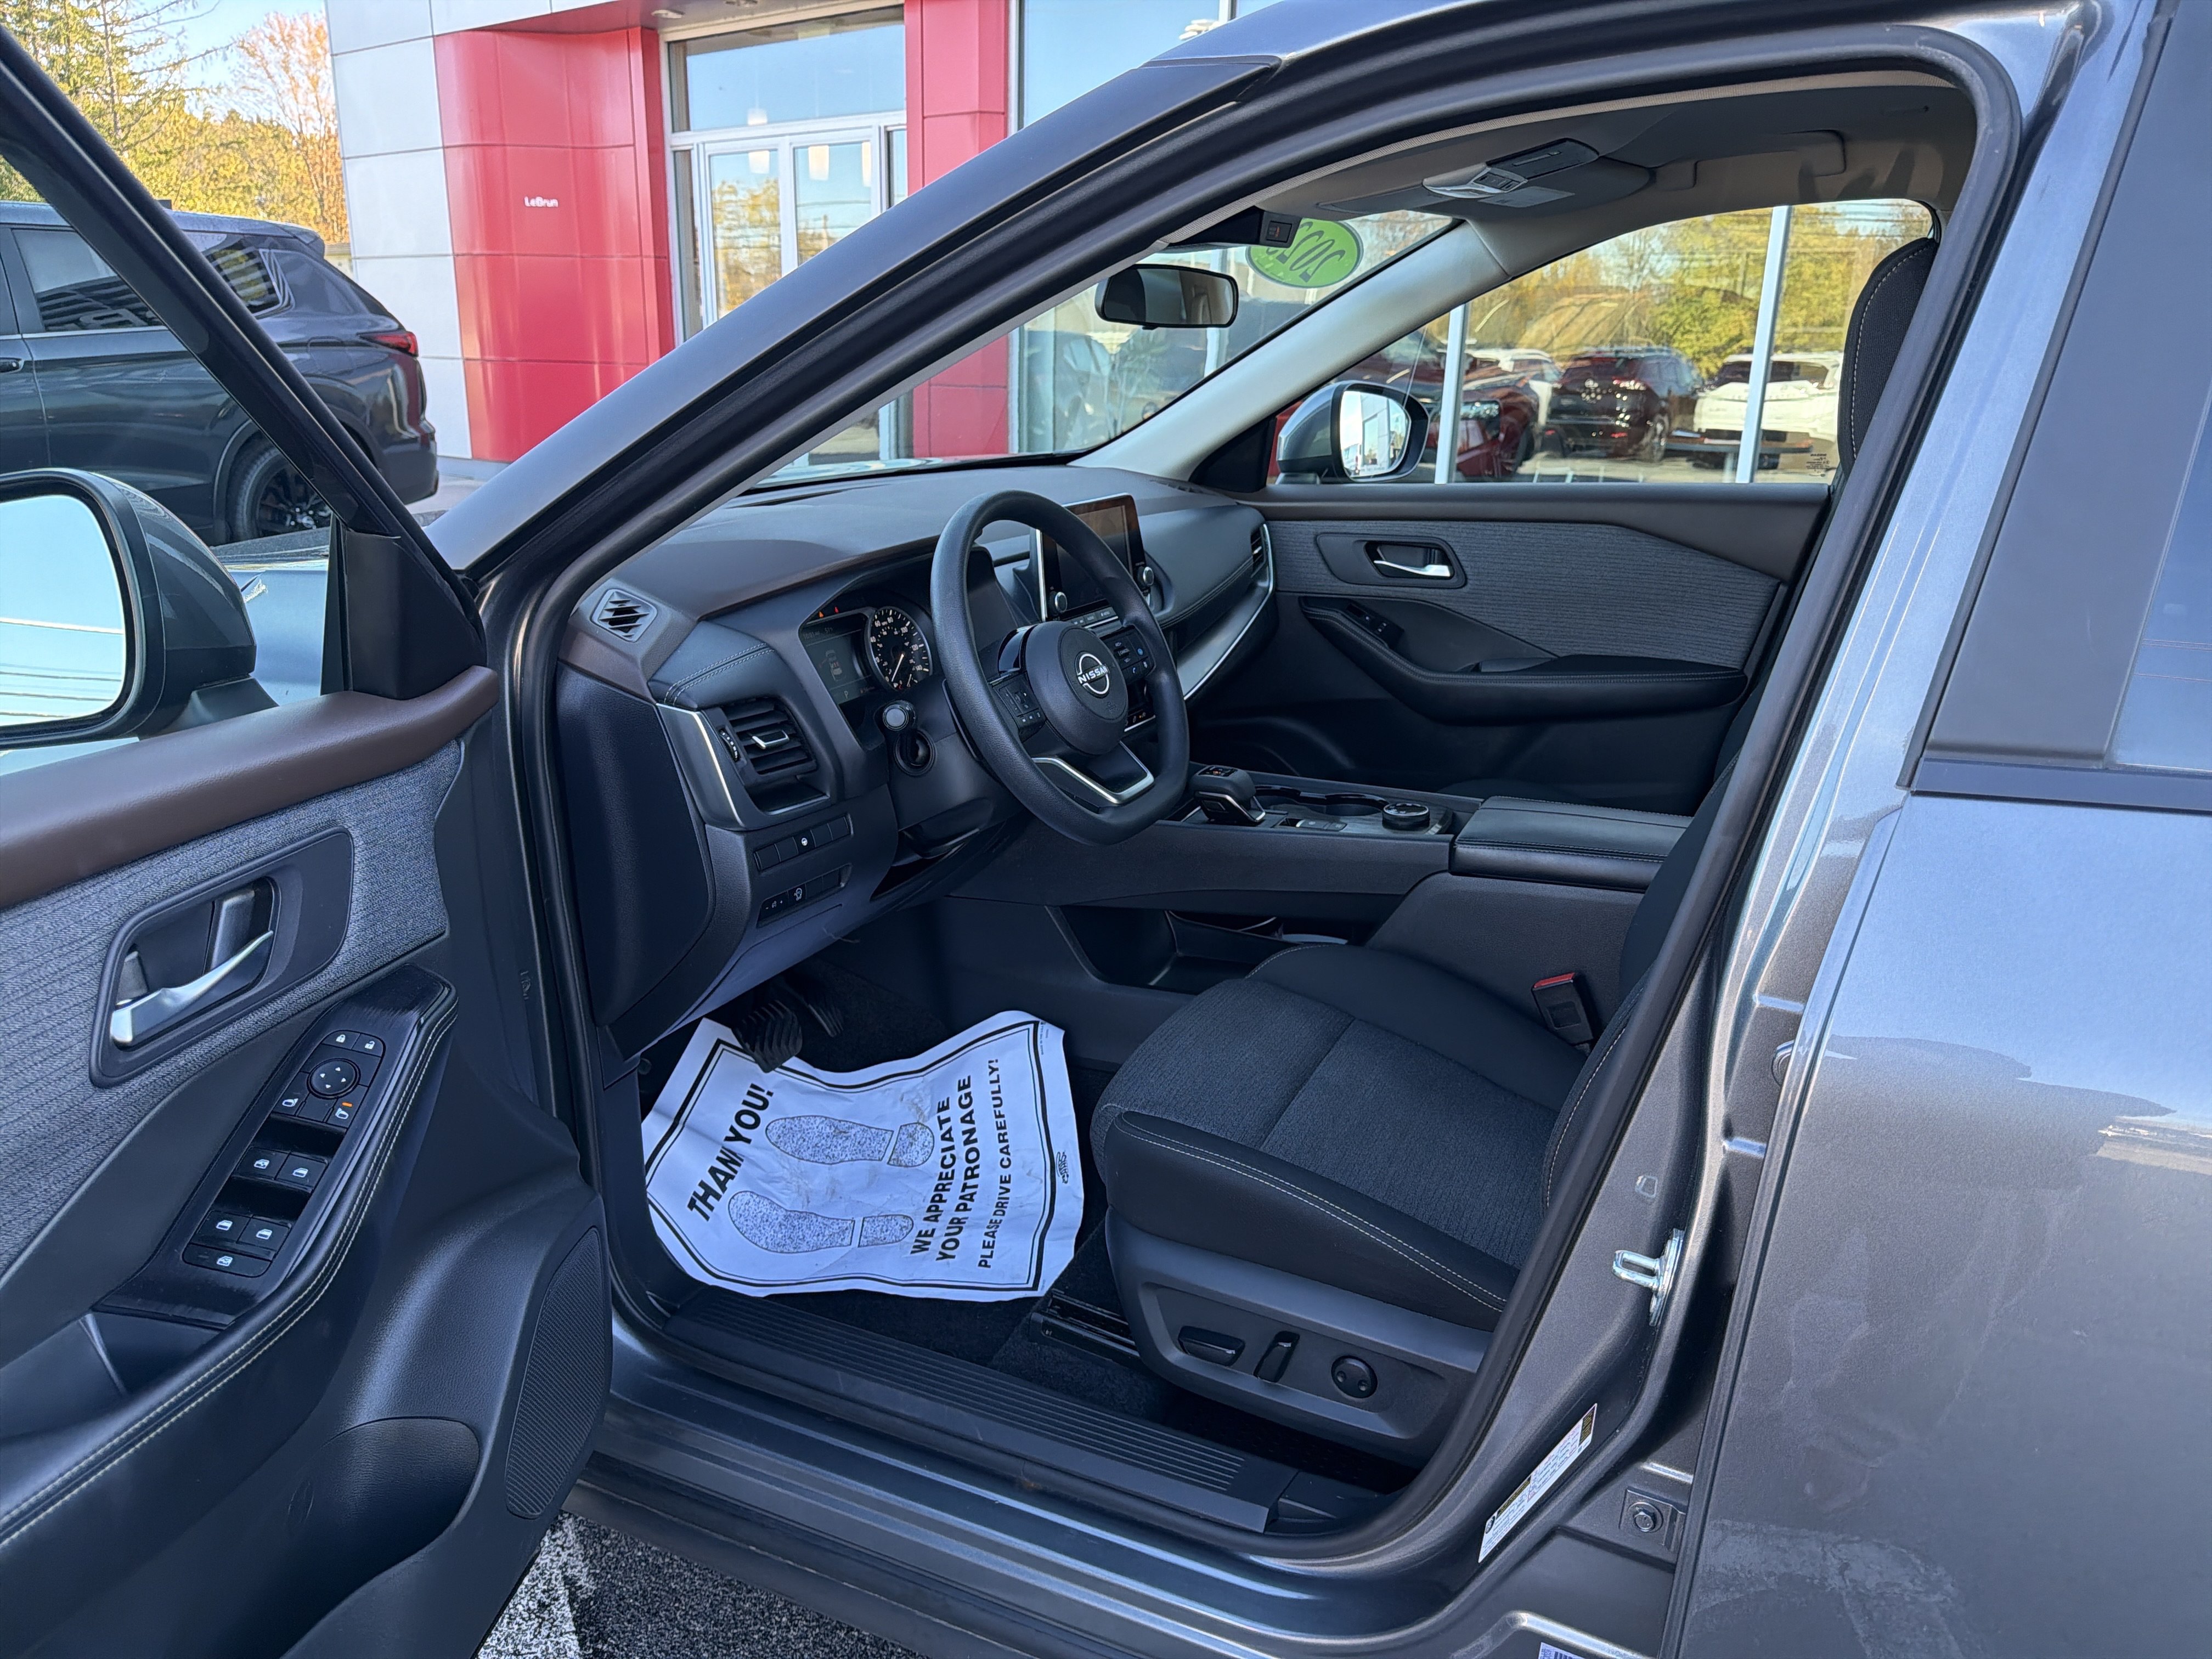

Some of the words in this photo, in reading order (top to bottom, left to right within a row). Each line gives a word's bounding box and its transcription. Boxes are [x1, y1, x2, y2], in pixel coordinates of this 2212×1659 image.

[1077, 665, 1108, 684] NISSAN
[723, 1082, 774, 1145] YOU!
[988, 1059, 1012, 1169] CAREFULLY!
[922, 1096, 957, 1223] APPRECIATE
[935, 1216, 969, 1262] YOUR
[954, 1075, 980, 1212] PATRONAGE
[995, 1174, 1012, 1217] DRIVE
[910, 1228, 936, 1255] WE
[978, 1218, 1003, 1269] PLEASE
